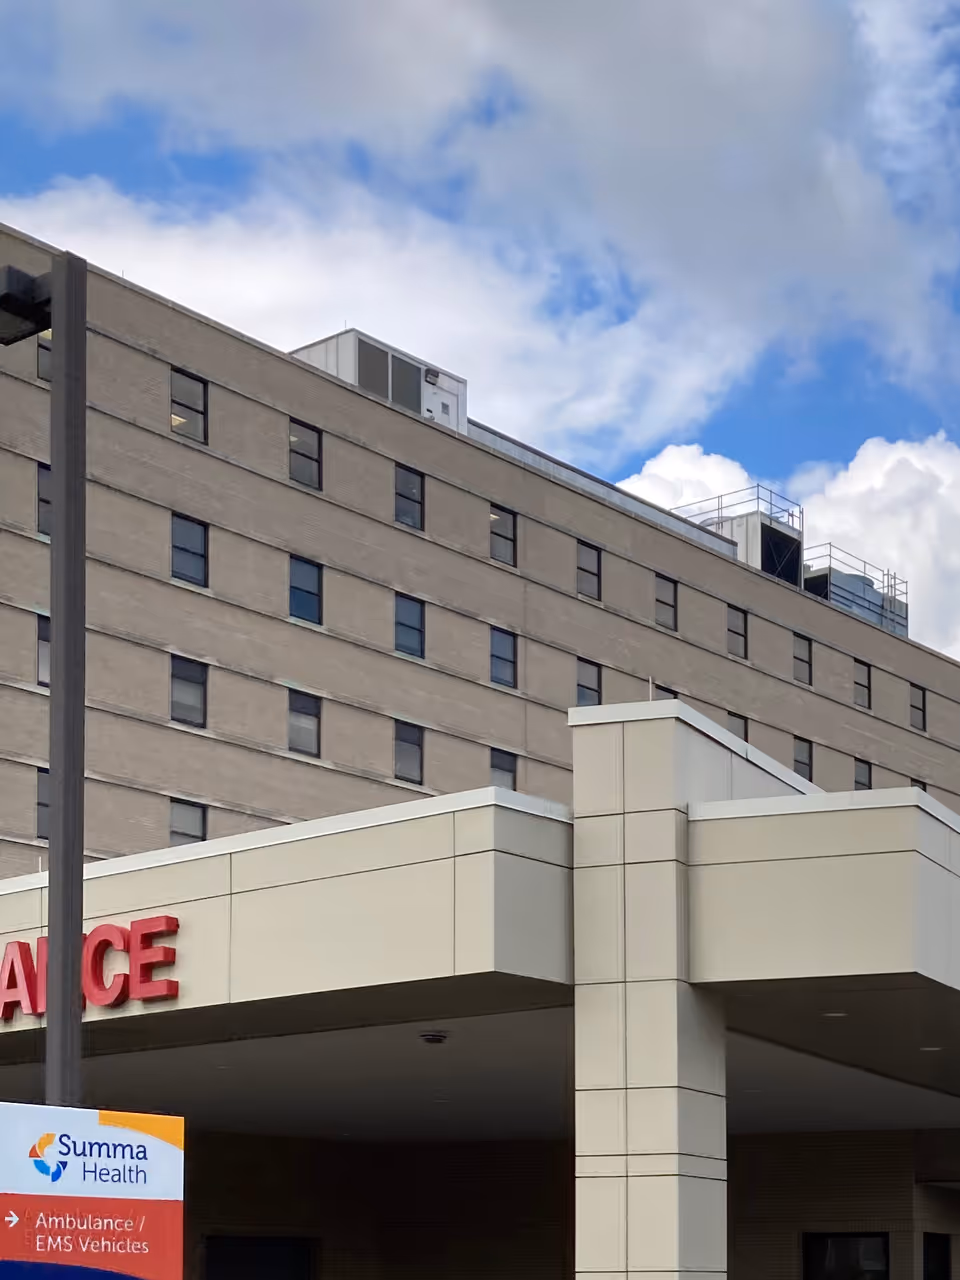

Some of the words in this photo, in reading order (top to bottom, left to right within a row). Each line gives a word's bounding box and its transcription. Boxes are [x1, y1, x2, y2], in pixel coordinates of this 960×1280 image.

[58, 1133, 149, 1161] Summa
[82, 1161, 148, 1185] Health
[35, 1212, 134, 1231] Ambulance
[35, 1234, 73, 1252] EMS
[79, 1237, 149, 1254] Vehicles
